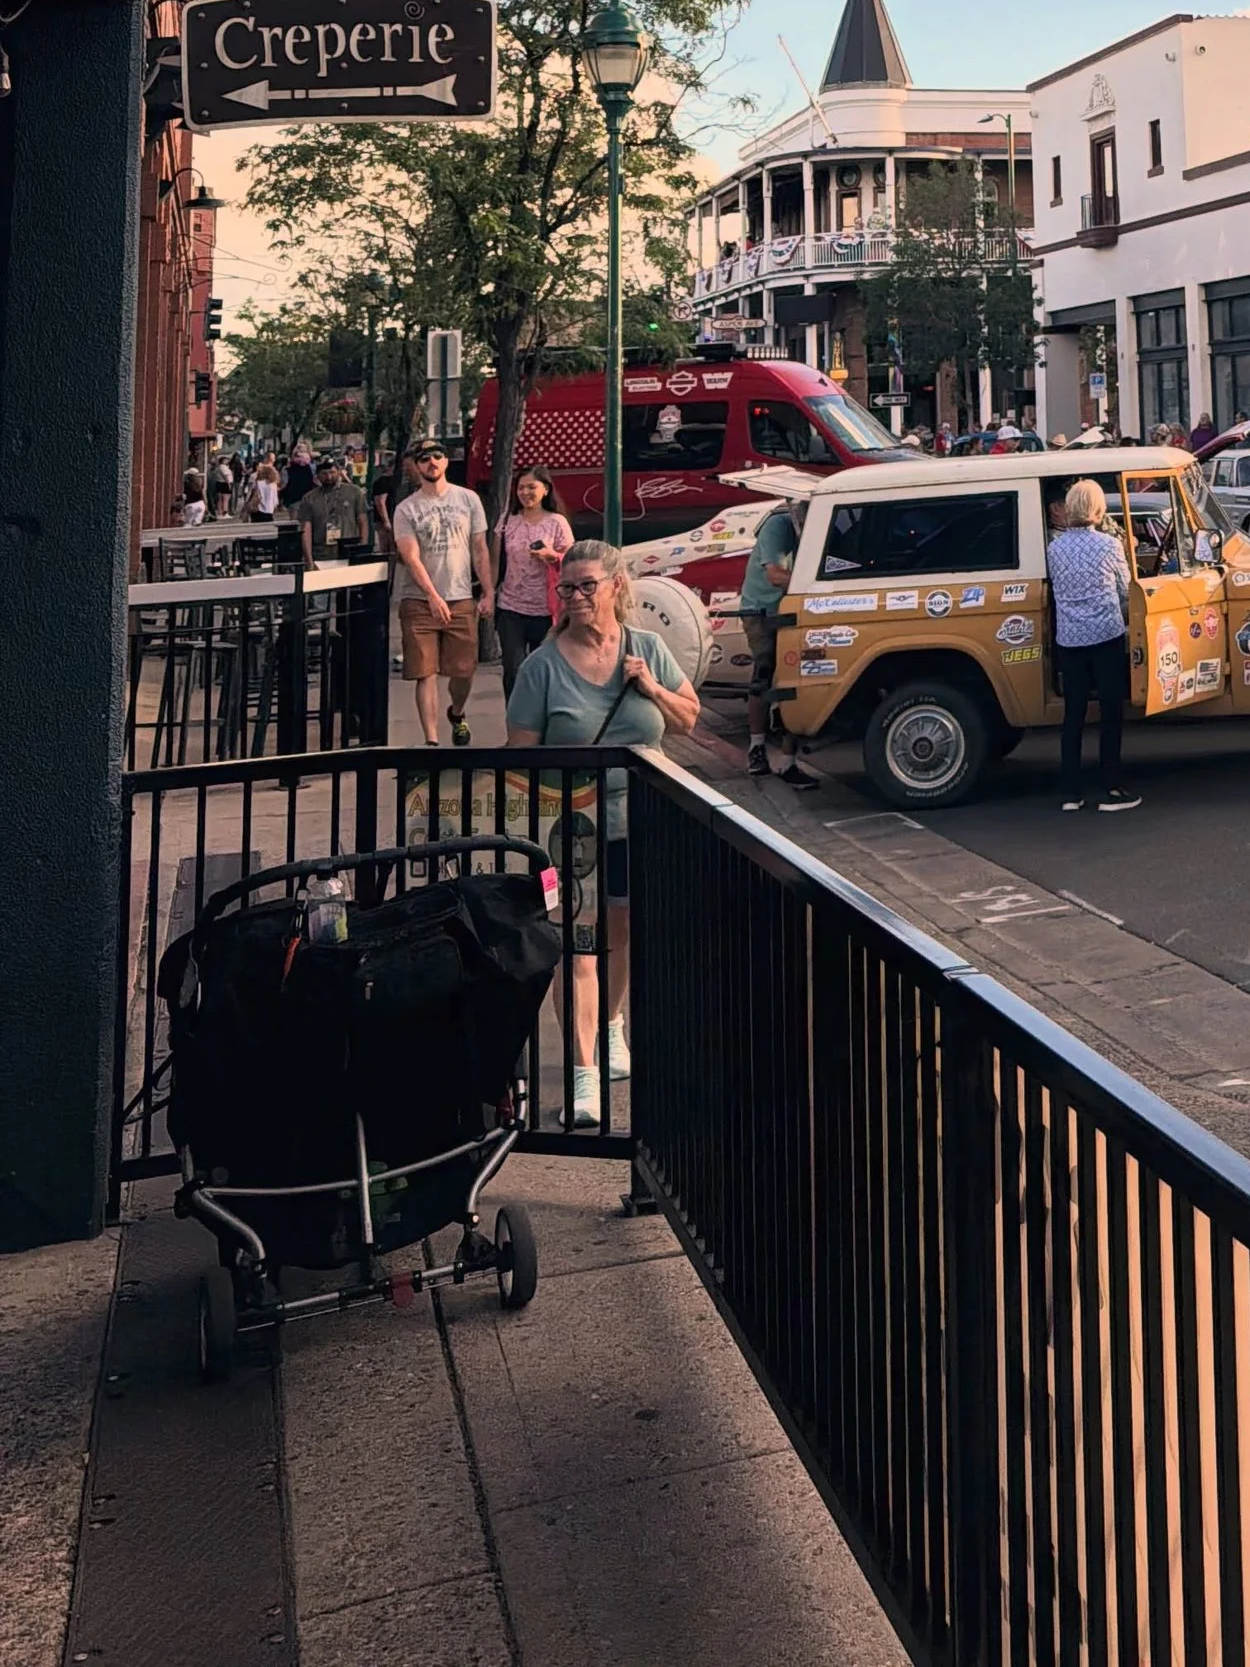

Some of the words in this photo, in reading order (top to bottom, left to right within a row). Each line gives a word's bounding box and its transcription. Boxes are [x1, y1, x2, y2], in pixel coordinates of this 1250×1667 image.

[214, 1, 456, 79] Creperie
[1004, 585, 1026, 594] WIX
[1004, 648, 1041, 663] JEGS
[1160, 651, 1178, 668] 150
